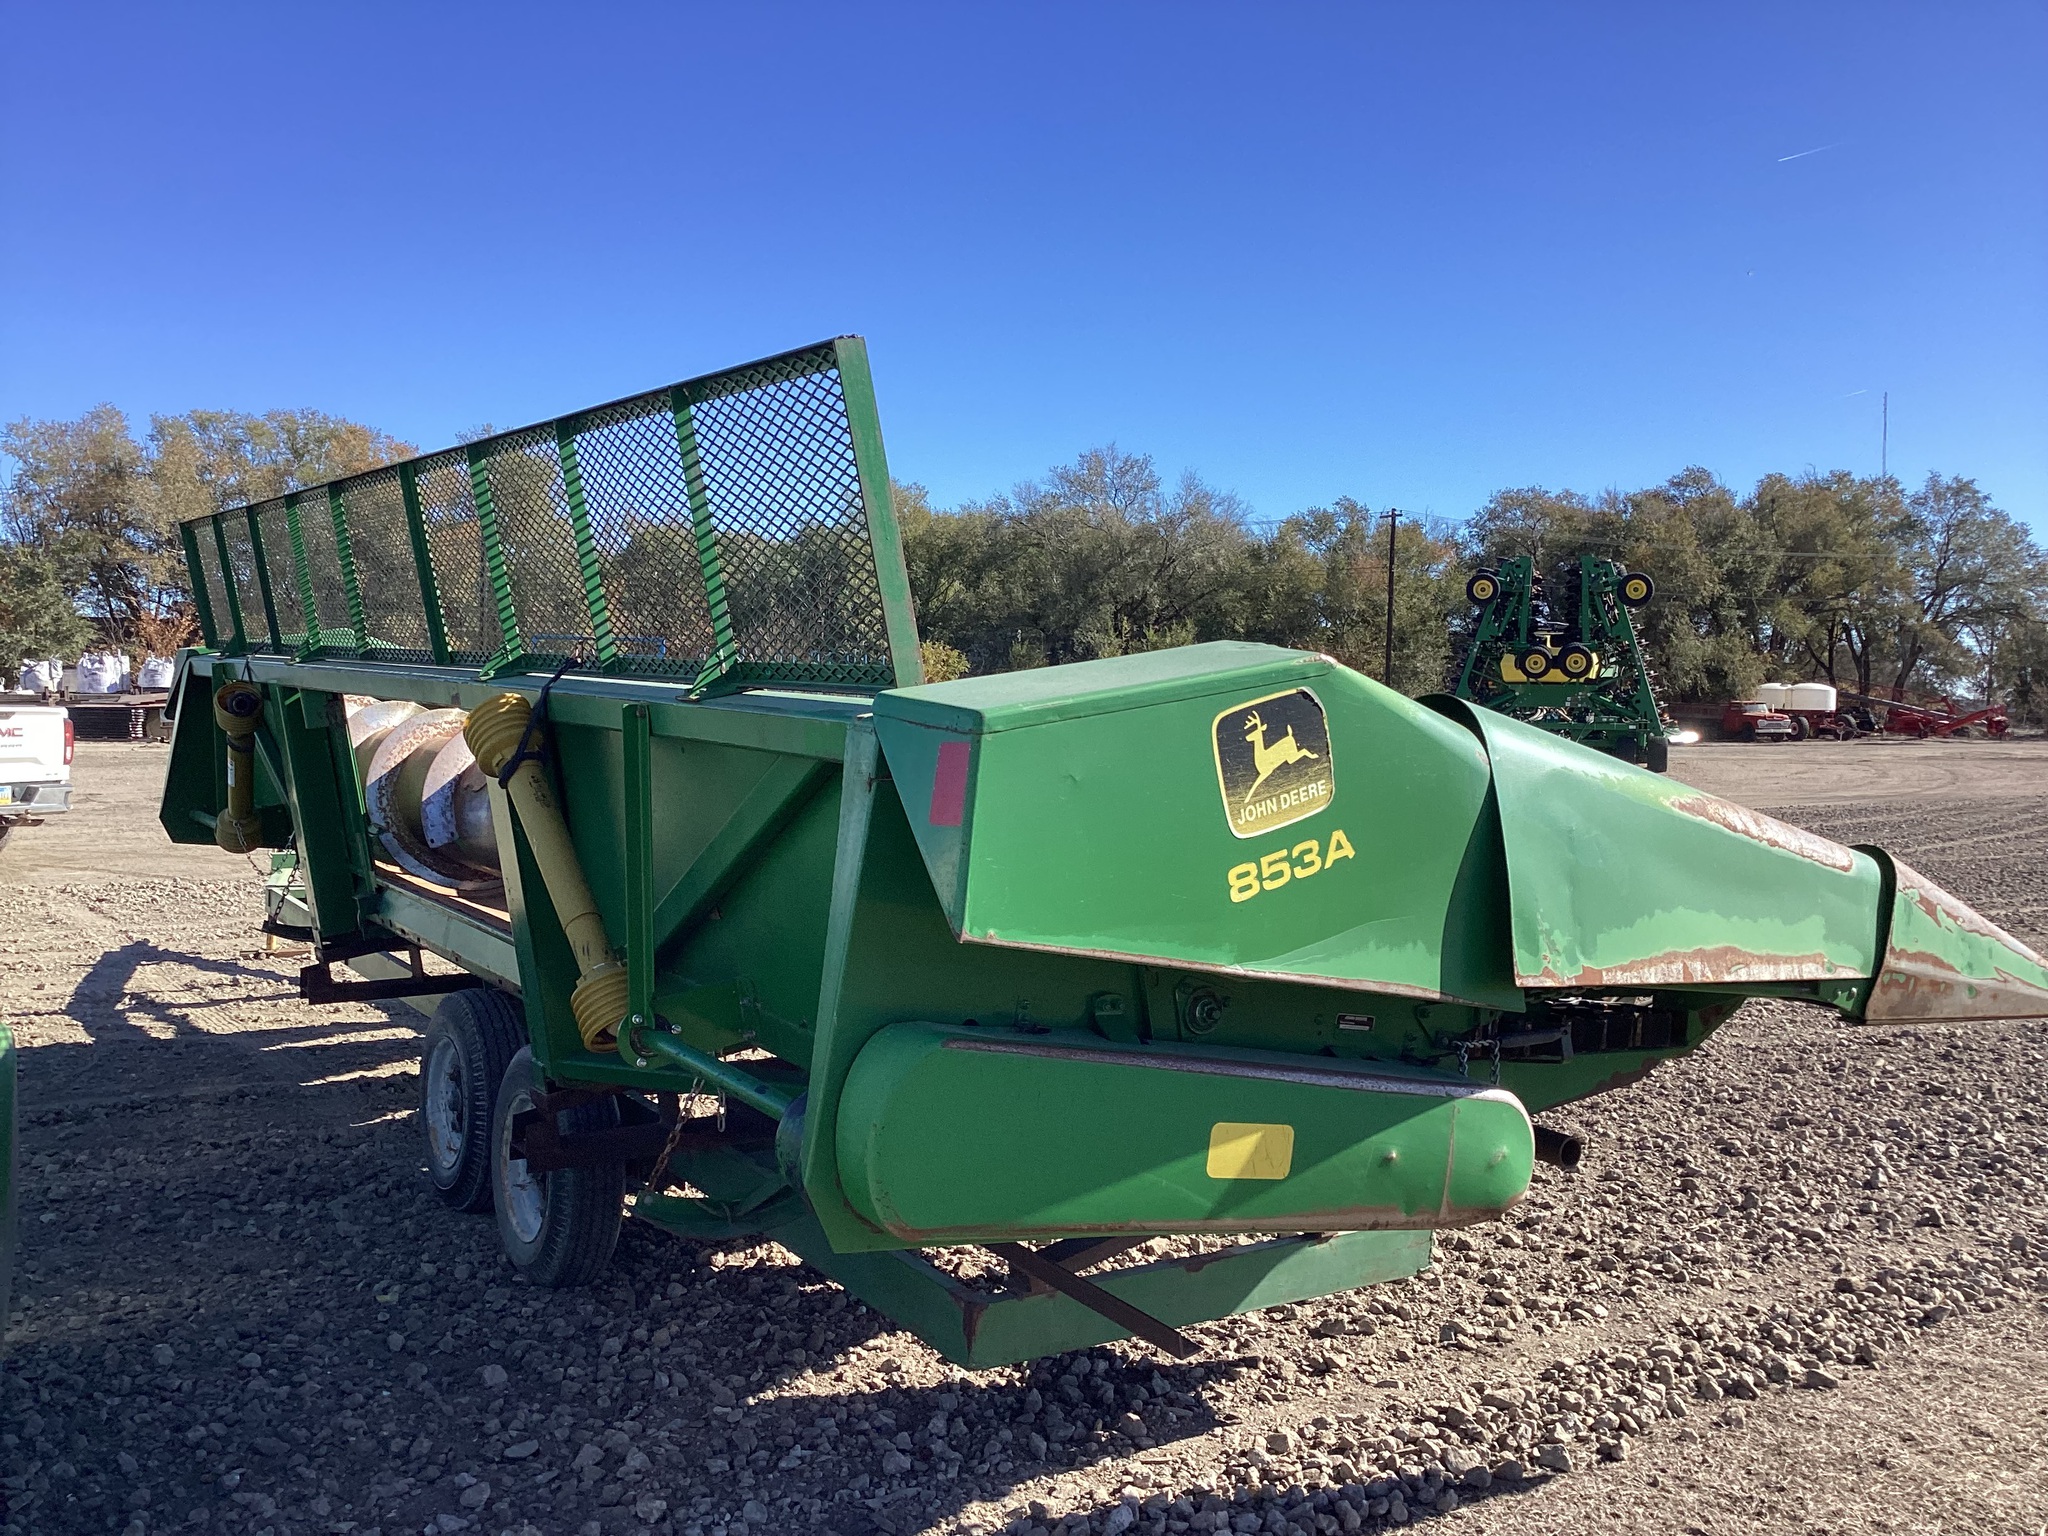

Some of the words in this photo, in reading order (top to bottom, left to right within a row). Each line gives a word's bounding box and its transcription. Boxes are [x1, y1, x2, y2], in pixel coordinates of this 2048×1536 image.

[0, 727, 24, 737] MC
[1237, 797, 1278, 825] JOHN
[1280, 779, 1328, 810] DEERE
[1227, 829, 1356, 903] 853A
